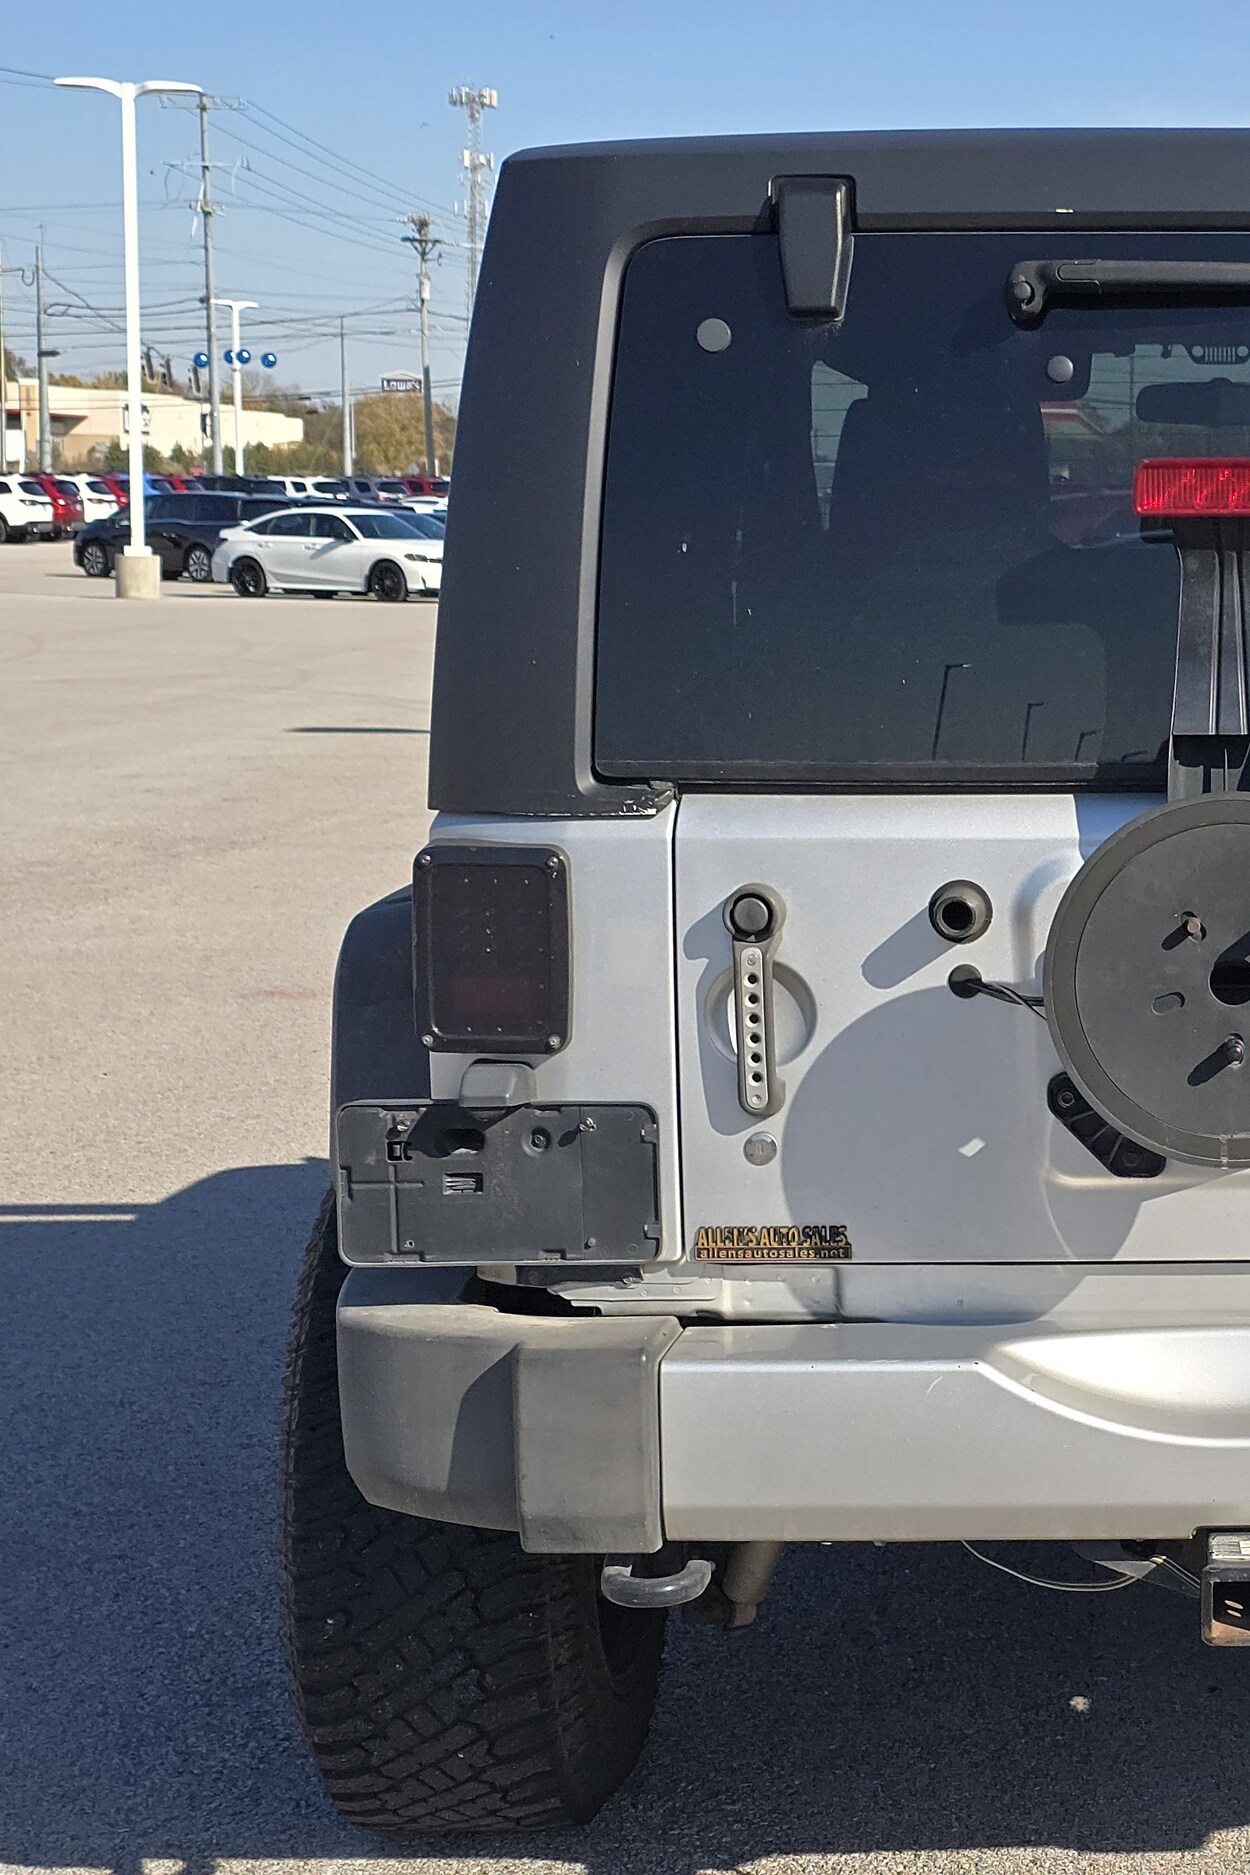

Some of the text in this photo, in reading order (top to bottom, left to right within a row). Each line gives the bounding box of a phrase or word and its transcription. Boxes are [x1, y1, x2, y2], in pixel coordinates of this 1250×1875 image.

[760, 1226, 799, 1247] AUTO
[802, 1225, 848, 1247] SALES
[699, 1247, 845, 1258] allensautosales.net
